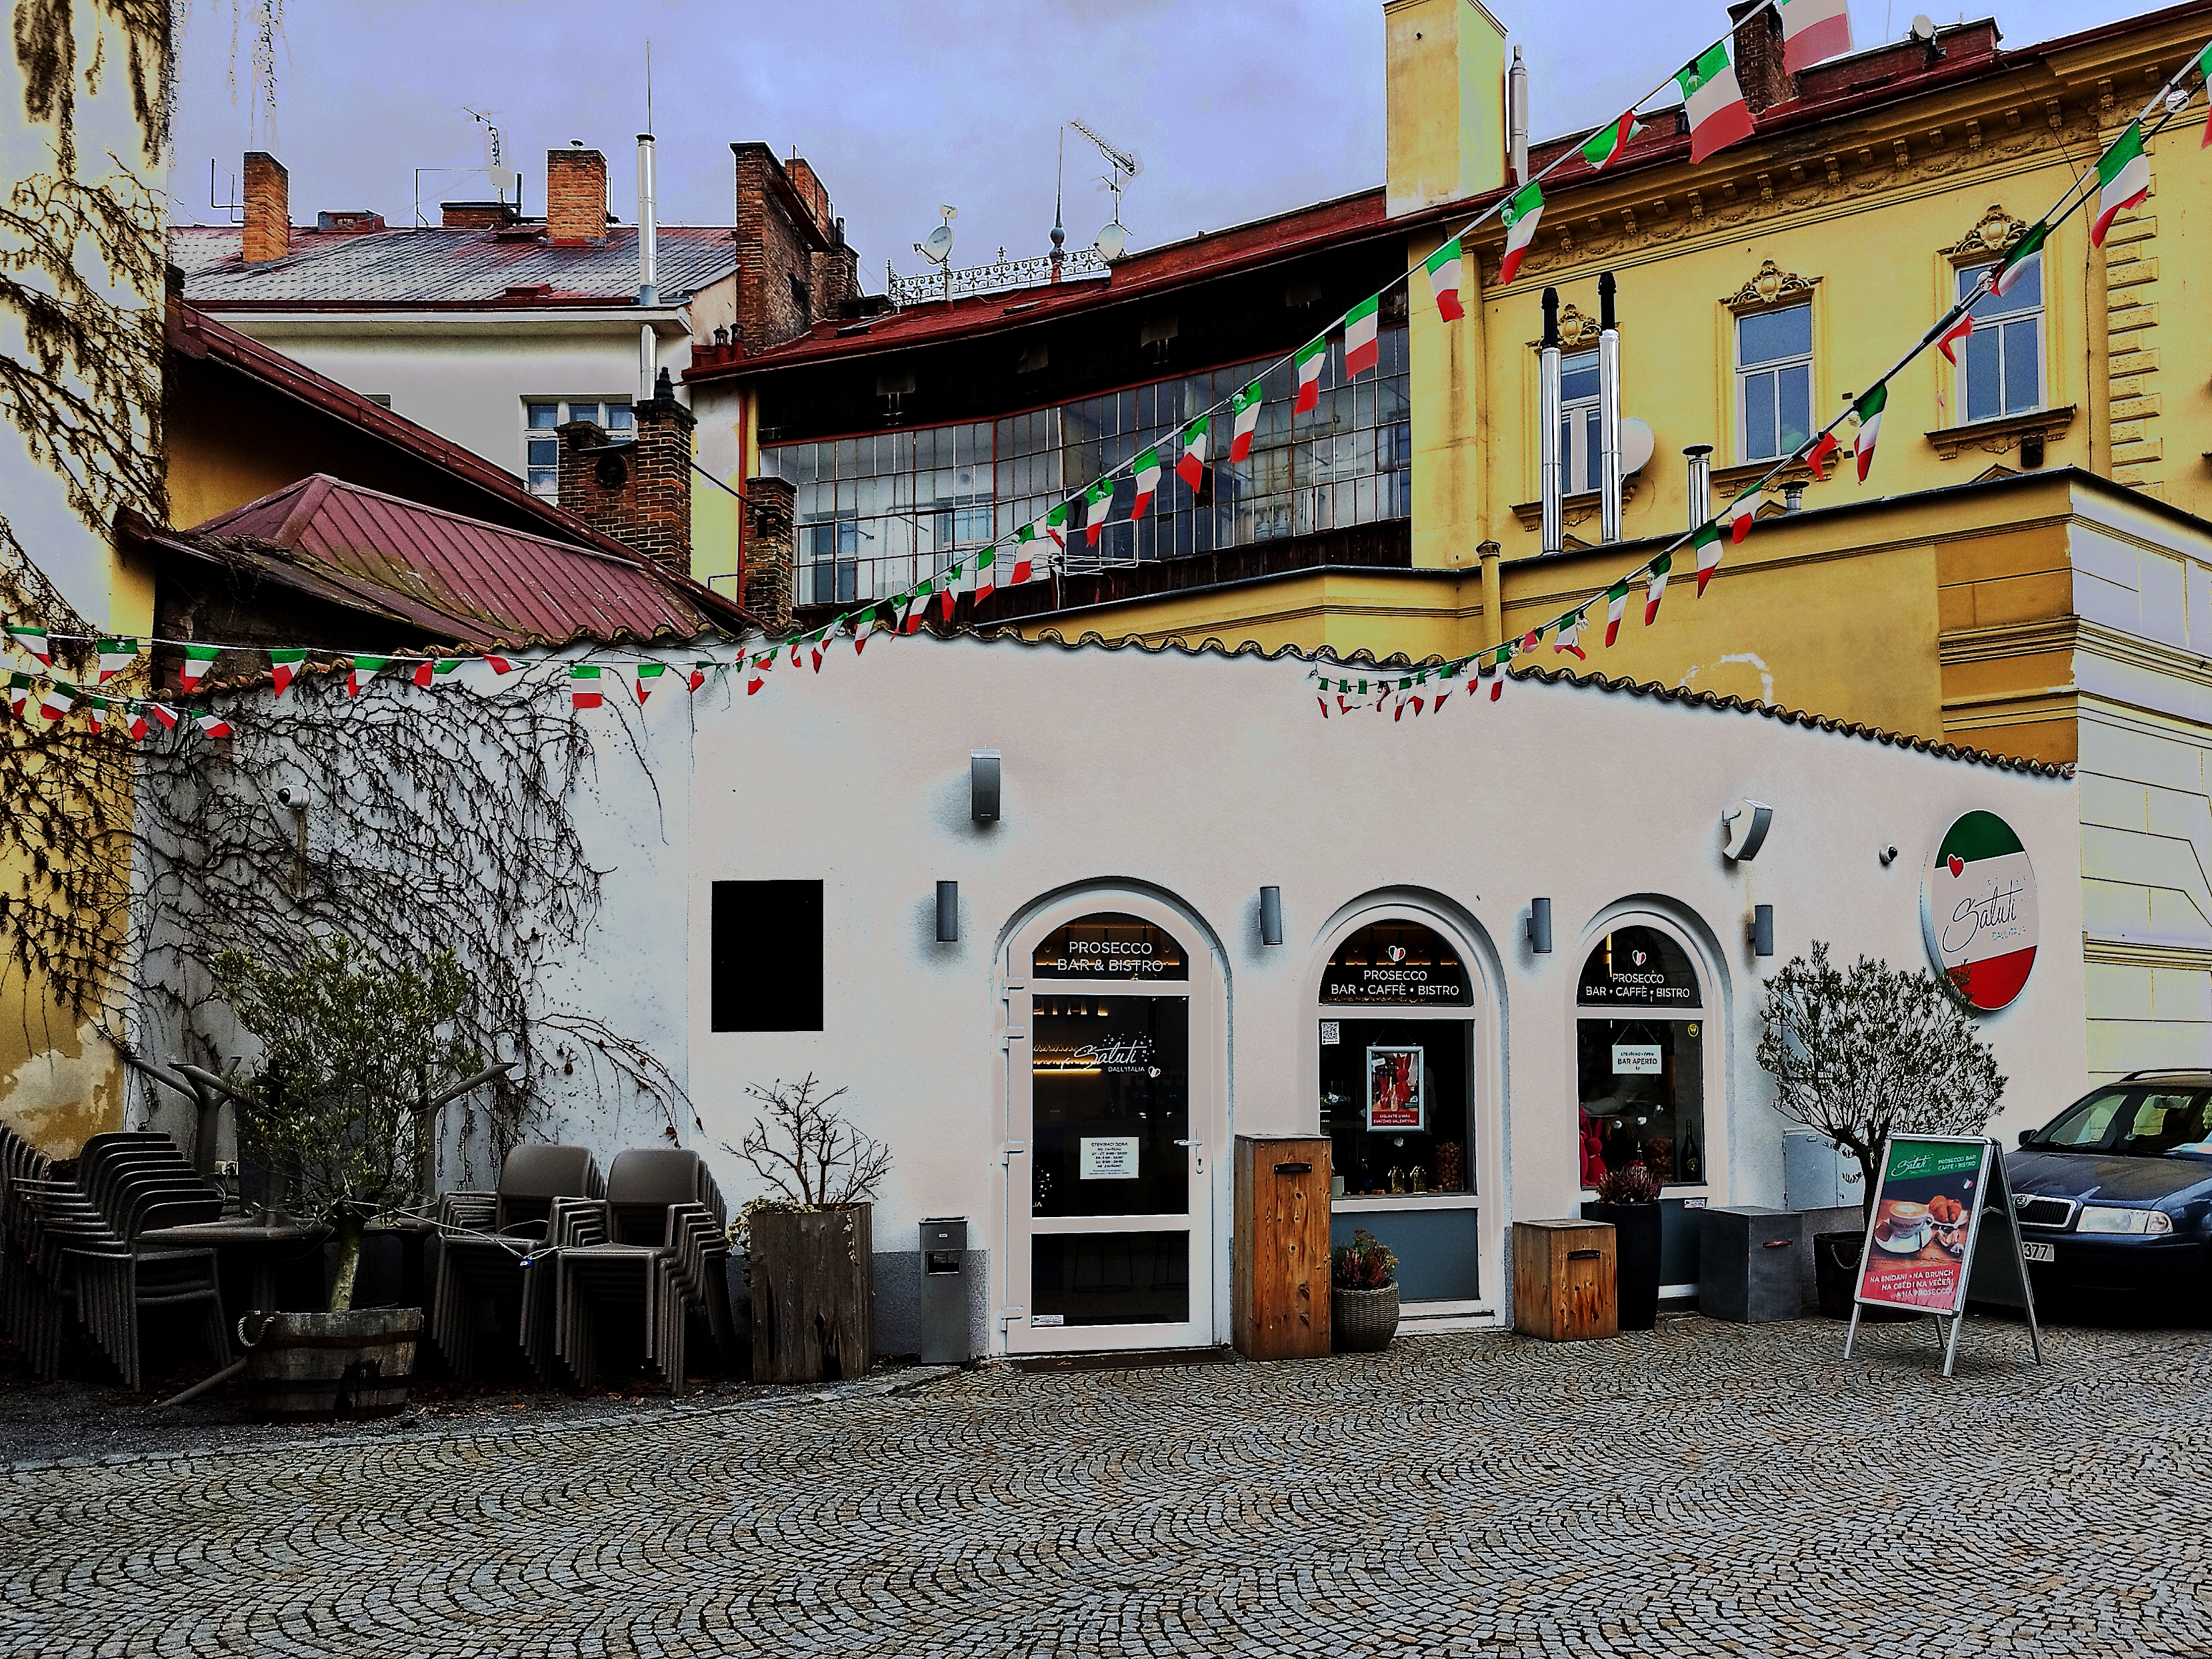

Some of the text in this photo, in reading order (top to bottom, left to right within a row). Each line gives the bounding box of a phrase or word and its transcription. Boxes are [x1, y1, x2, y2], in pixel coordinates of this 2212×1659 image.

[1942, 880, 2023, 952] Saluti
[1069, 941, 1153, 954] PROSECCO
[1057, 958, 1163, 972] BAR & BISTRO
[1363, 970, 1427, 980] PROSECCO
[1612, 973, 1665, 983] PROSECCO
[1331, 982, 1459, 995] BAR CAFFÈ BISTRO
[1586, 985, 1690, 998] BAR CAFFÈ BISTRO
[1061, 1040, 1147, 1070] Saluti
[2023, 1243, 2049, 1260] 377
[1925, 1269, 1954, 1278] BRUNCH
